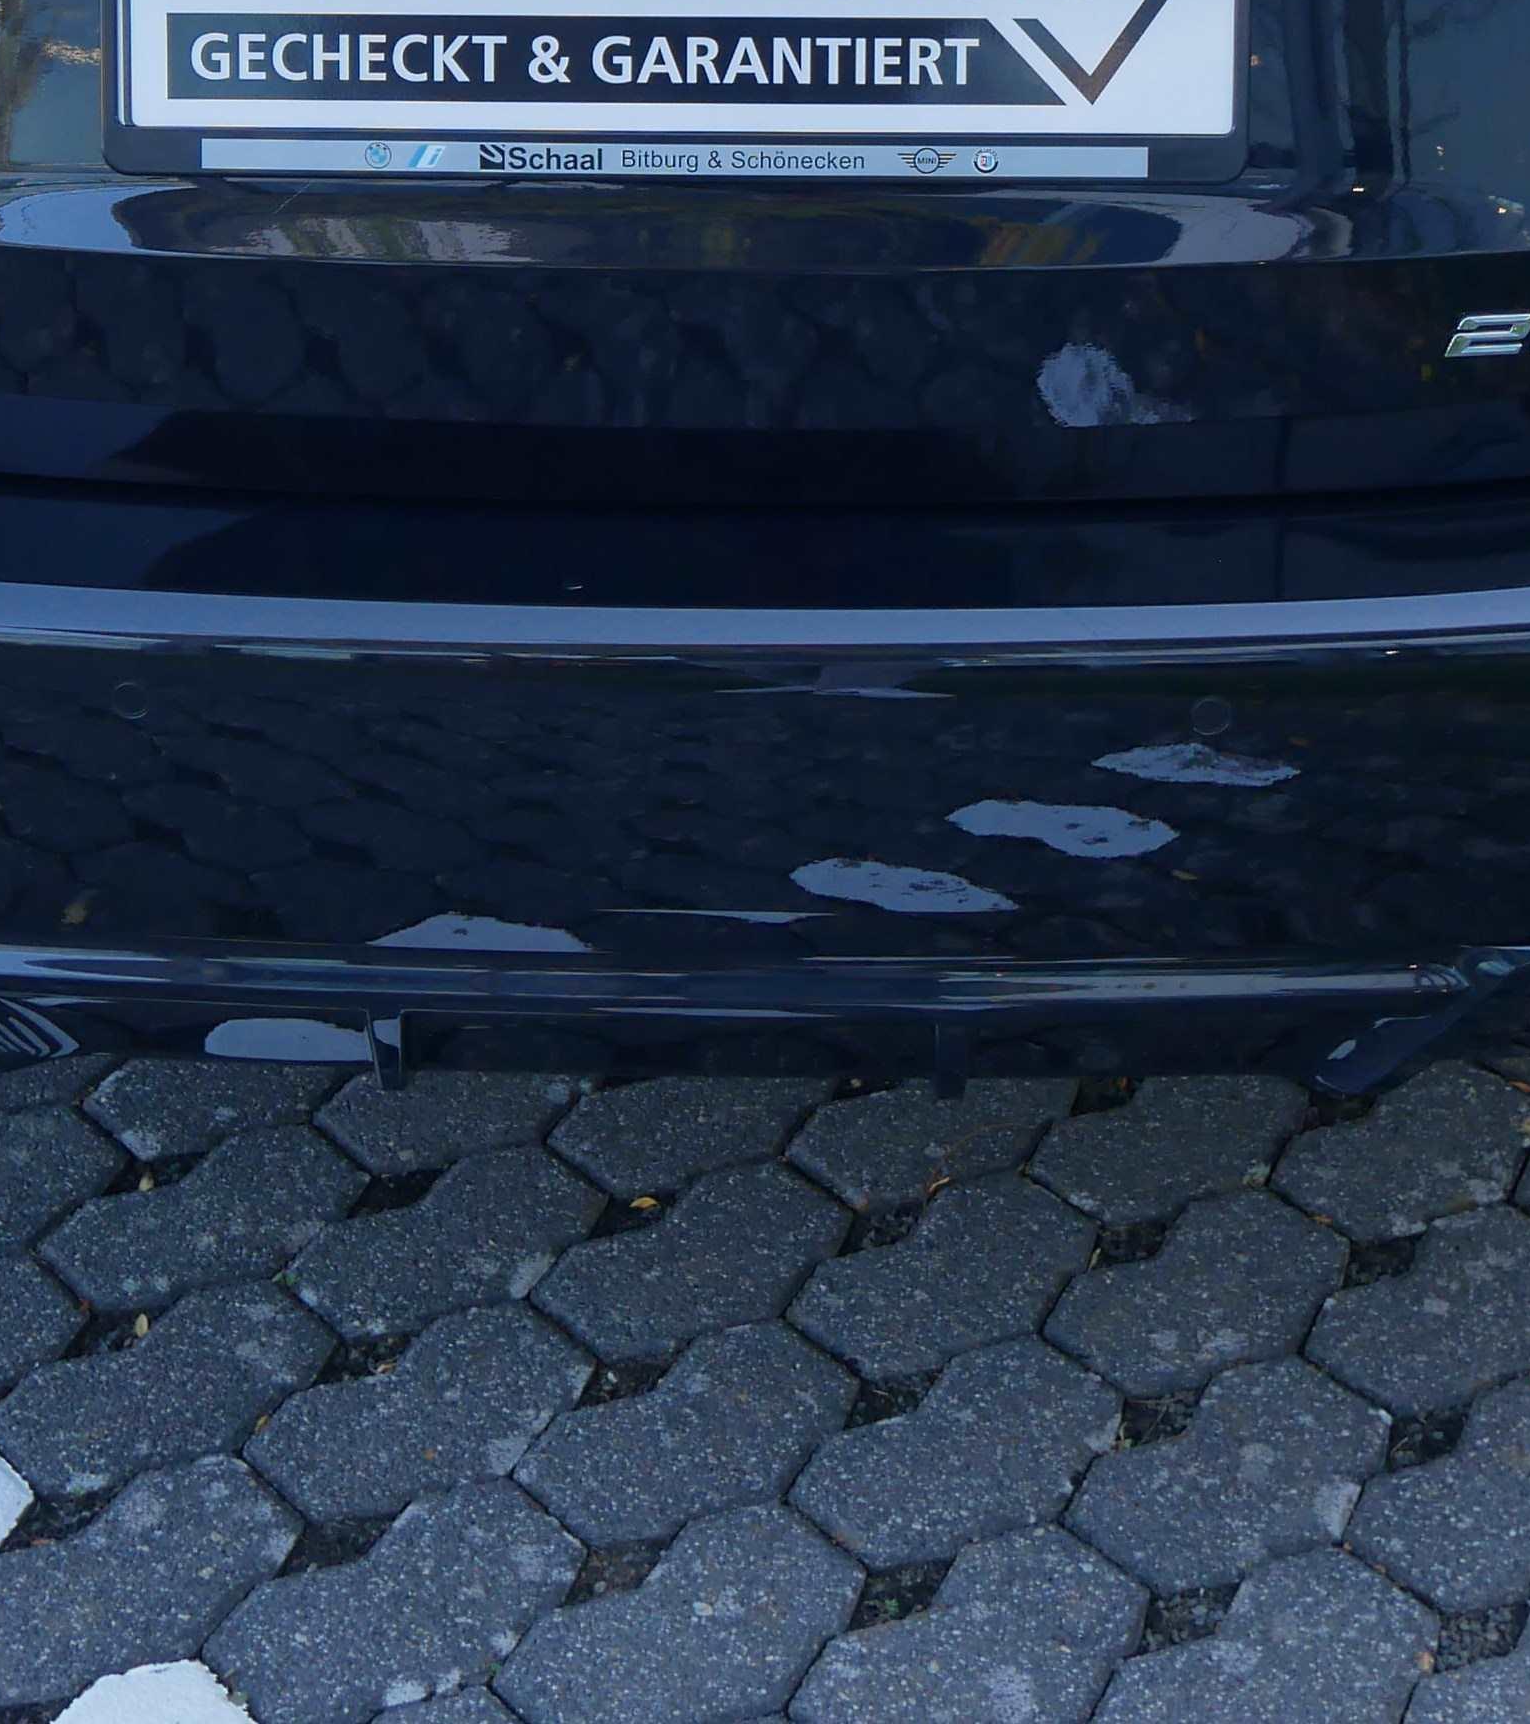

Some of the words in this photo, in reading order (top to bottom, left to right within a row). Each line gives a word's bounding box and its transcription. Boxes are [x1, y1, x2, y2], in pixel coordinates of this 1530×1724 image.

[189, 31, 509, 84] GECHECKT
[528, 34, 572, 85] &
[591, 35, 982, 87] GARANTIERT
[507, 146, 604, 172] Schaal
[621, 149, 700, 174] Bitburg
[707, 150, 724, 170] &
[731, 150, 866, 171] Schönecken
[917, 157, 937, 165] MINI
